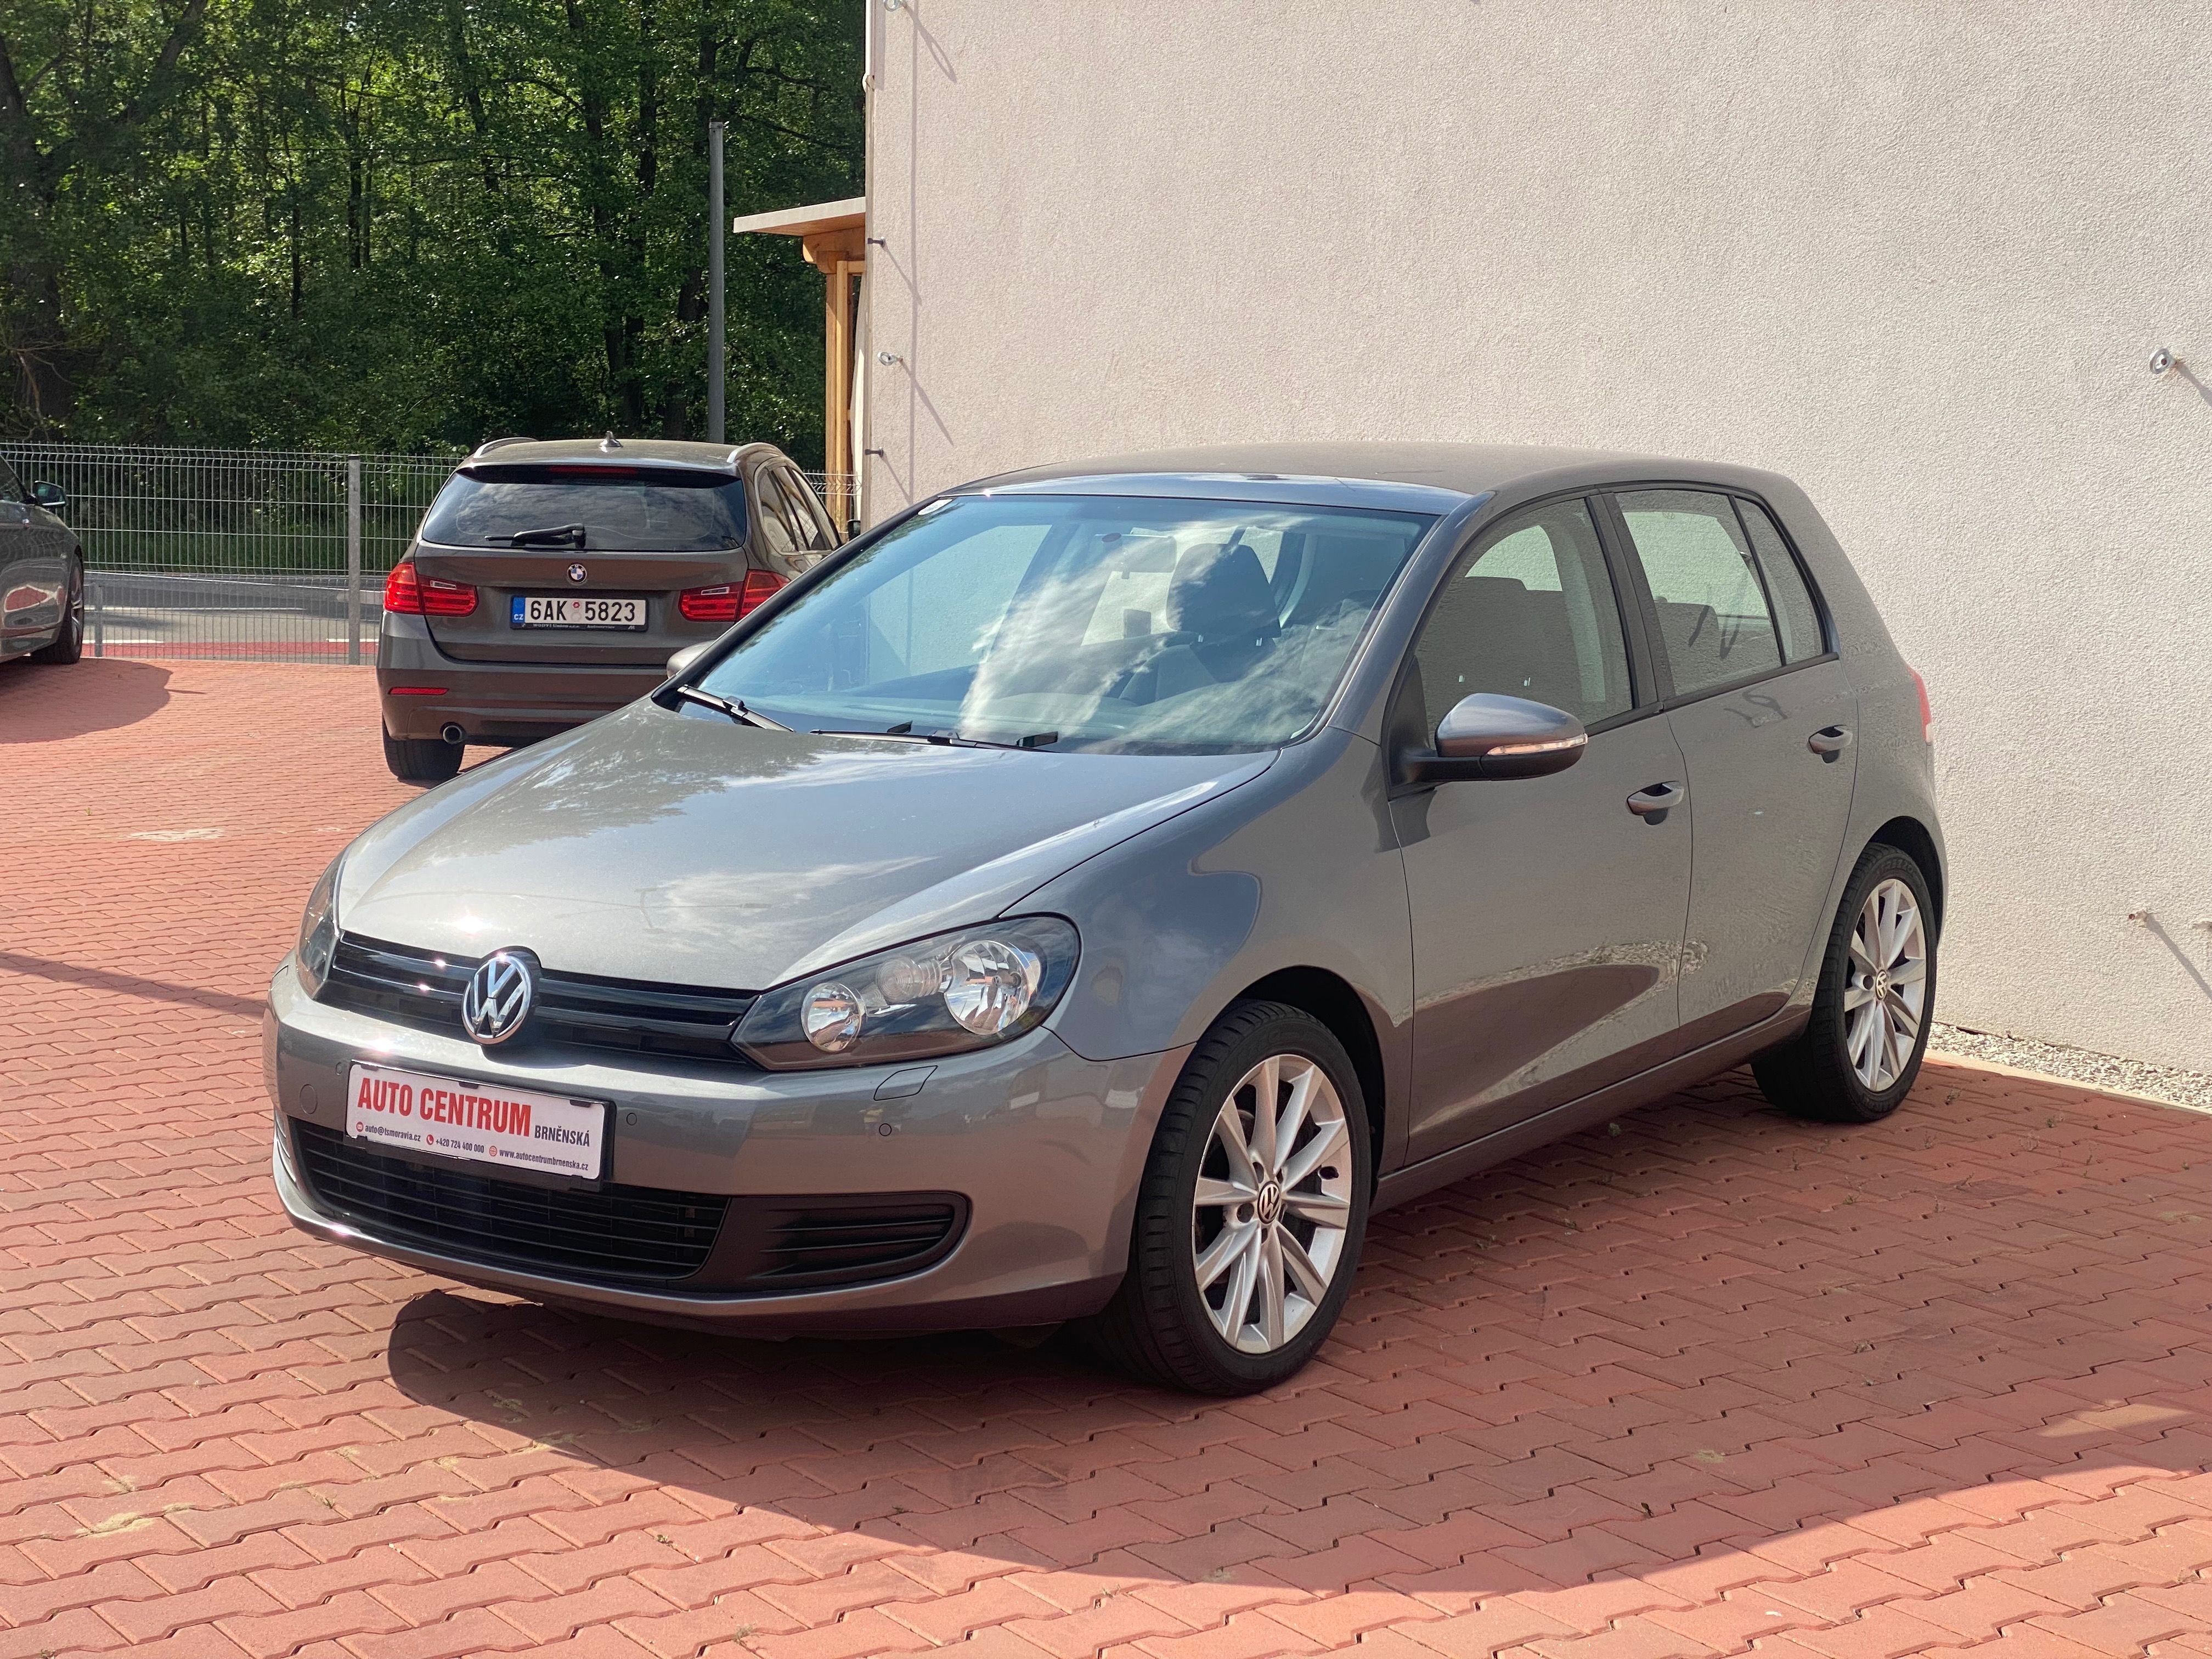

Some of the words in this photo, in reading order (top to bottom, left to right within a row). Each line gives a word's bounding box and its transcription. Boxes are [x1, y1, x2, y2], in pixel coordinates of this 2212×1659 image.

[531, 600, 567, 621] 6AK
[585, 601, 635, 622] 5823
[467, 957, 529, 1038] VW
[357, 1077, 413, 1117] AUTO
[419, 1087, 532, 1137] CENTRUM
[534, 1125, 590, 1147] BRNĚNSKÁ
[436, 1138, 449, 1147] +420
[450, 1140, 461, 1149] 724
[462, 1142, 472, 1151] 400
[473, 1144, 484, 1153] 000
[499, 1149, 589, 1171] www.autocentrumbrnenska.cz
